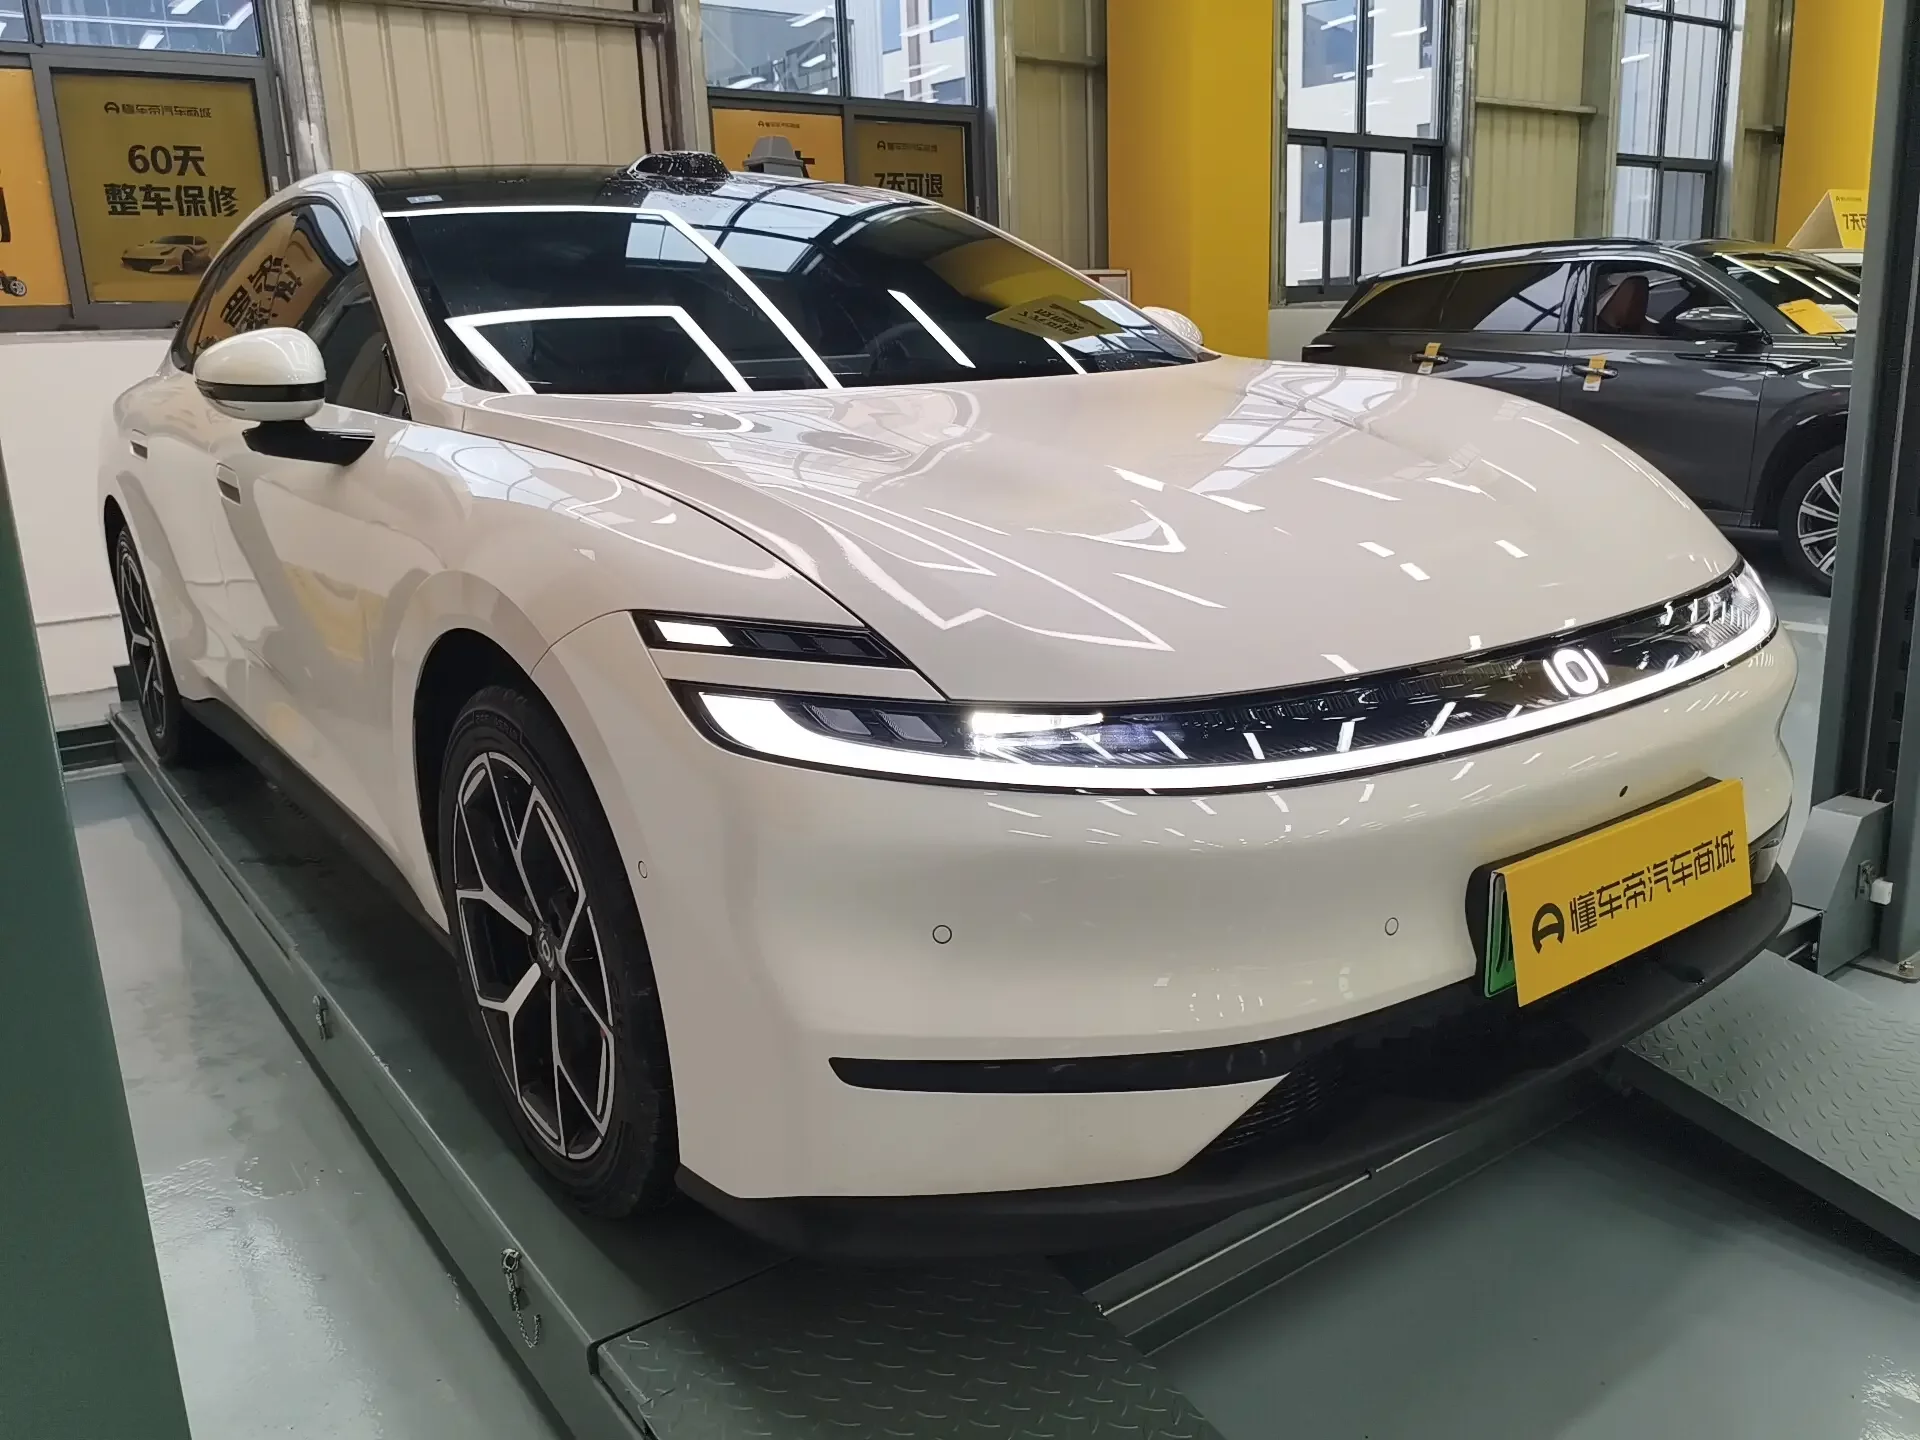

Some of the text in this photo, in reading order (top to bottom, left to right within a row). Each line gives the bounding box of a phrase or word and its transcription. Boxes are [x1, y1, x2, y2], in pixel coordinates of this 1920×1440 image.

[127, 144, 207, 177] 60天
[103, 183, 239, 217] 整车保修
[873, 172, 944, 198] 7天可退
[1569, 829, 1736, 935] 懂车帝汽车商城
